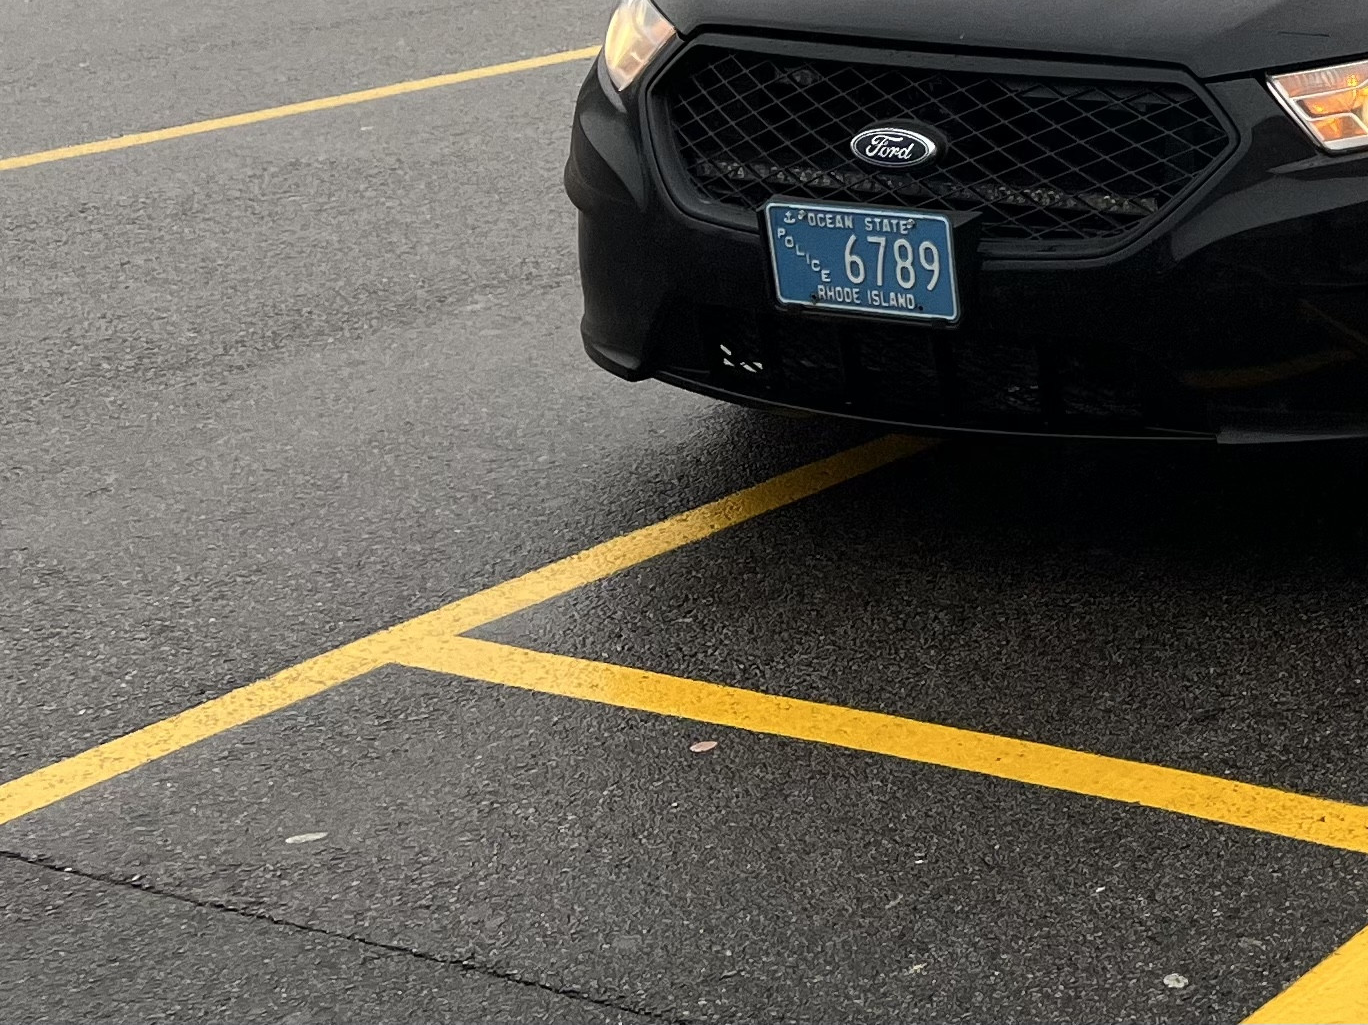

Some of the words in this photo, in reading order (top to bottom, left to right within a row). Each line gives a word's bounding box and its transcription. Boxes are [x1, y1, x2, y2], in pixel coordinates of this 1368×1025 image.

[865, 135, 915, 159] Ford
[807, 213, 854, 229] OCEAN
[864, 217, 909, 234] STATE
[777, 227, 831, 283] POLICE
[844, 234, 940, 291] 6789
[817, 285, 861, 304] RHODE
[868, 289, 915, 309] ISLAND
